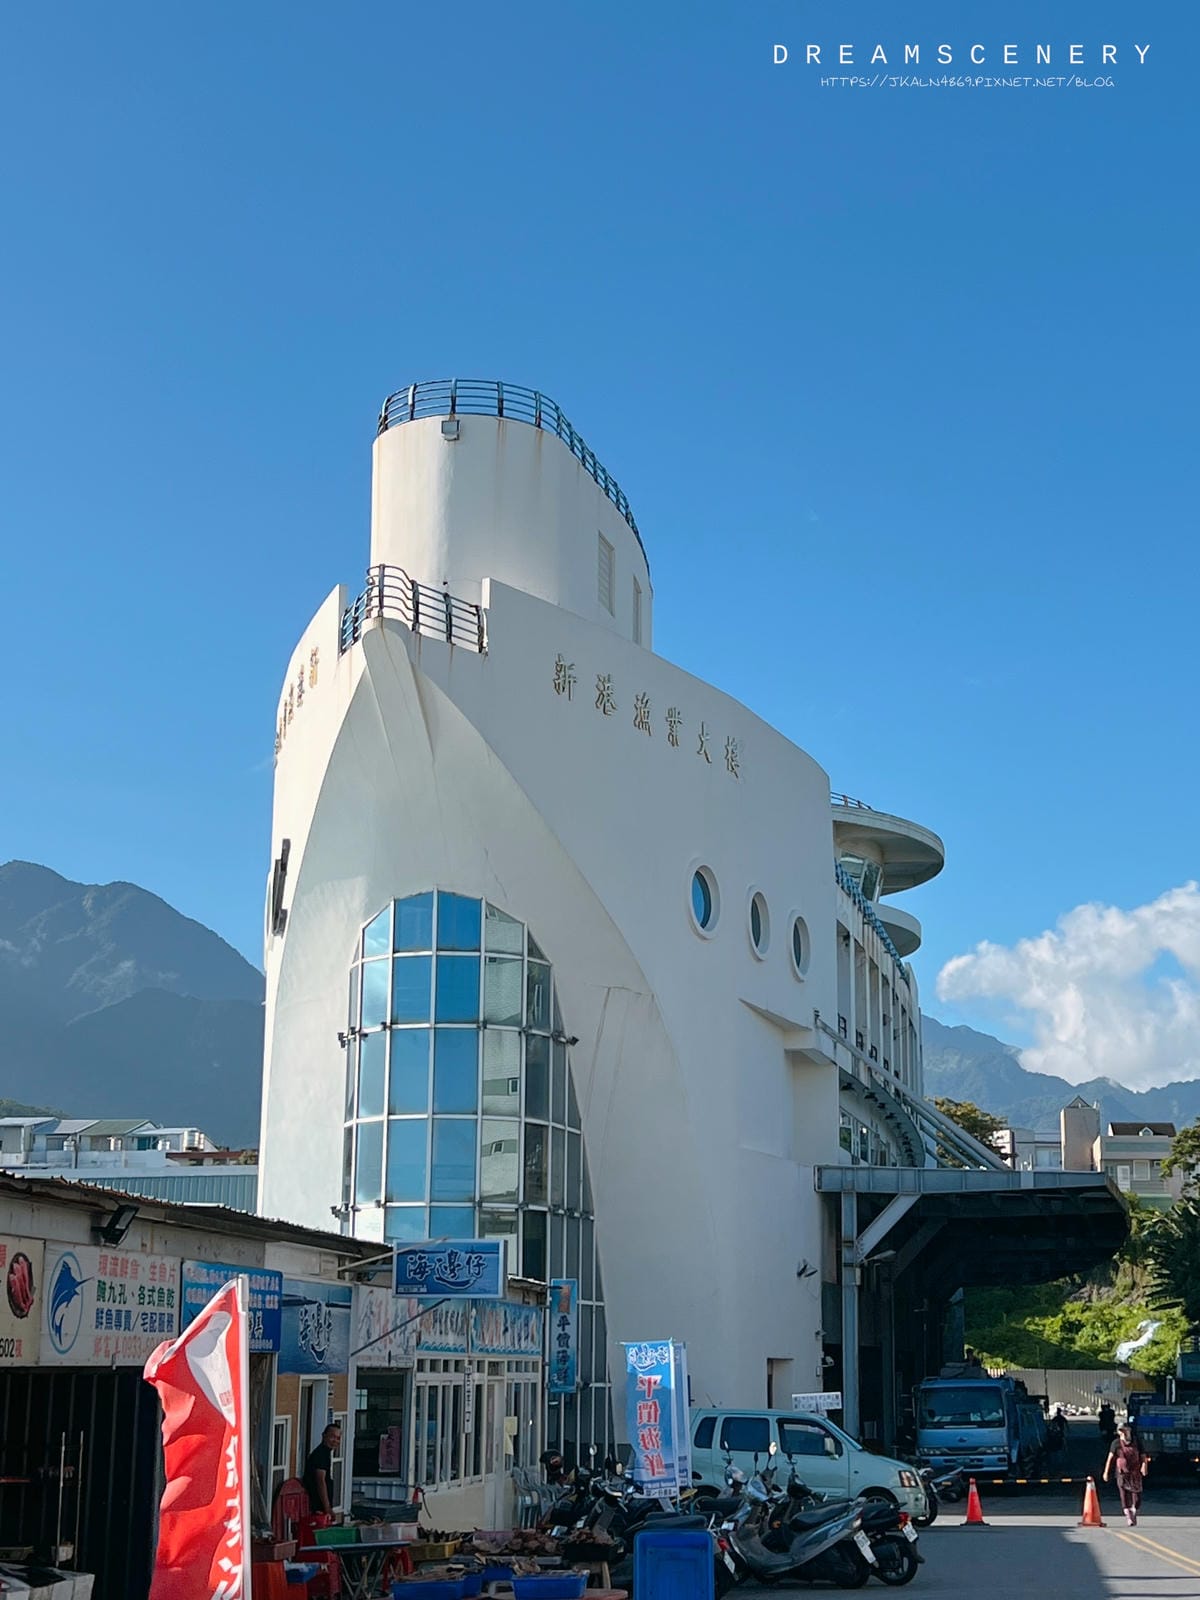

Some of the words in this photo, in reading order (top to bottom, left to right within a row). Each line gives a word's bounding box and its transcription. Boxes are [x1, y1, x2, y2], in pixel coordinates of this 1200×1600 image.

[552, 652, 742, 779] 新港漁業大樓
[406, 1247, 488, 1291] 海邊仔
